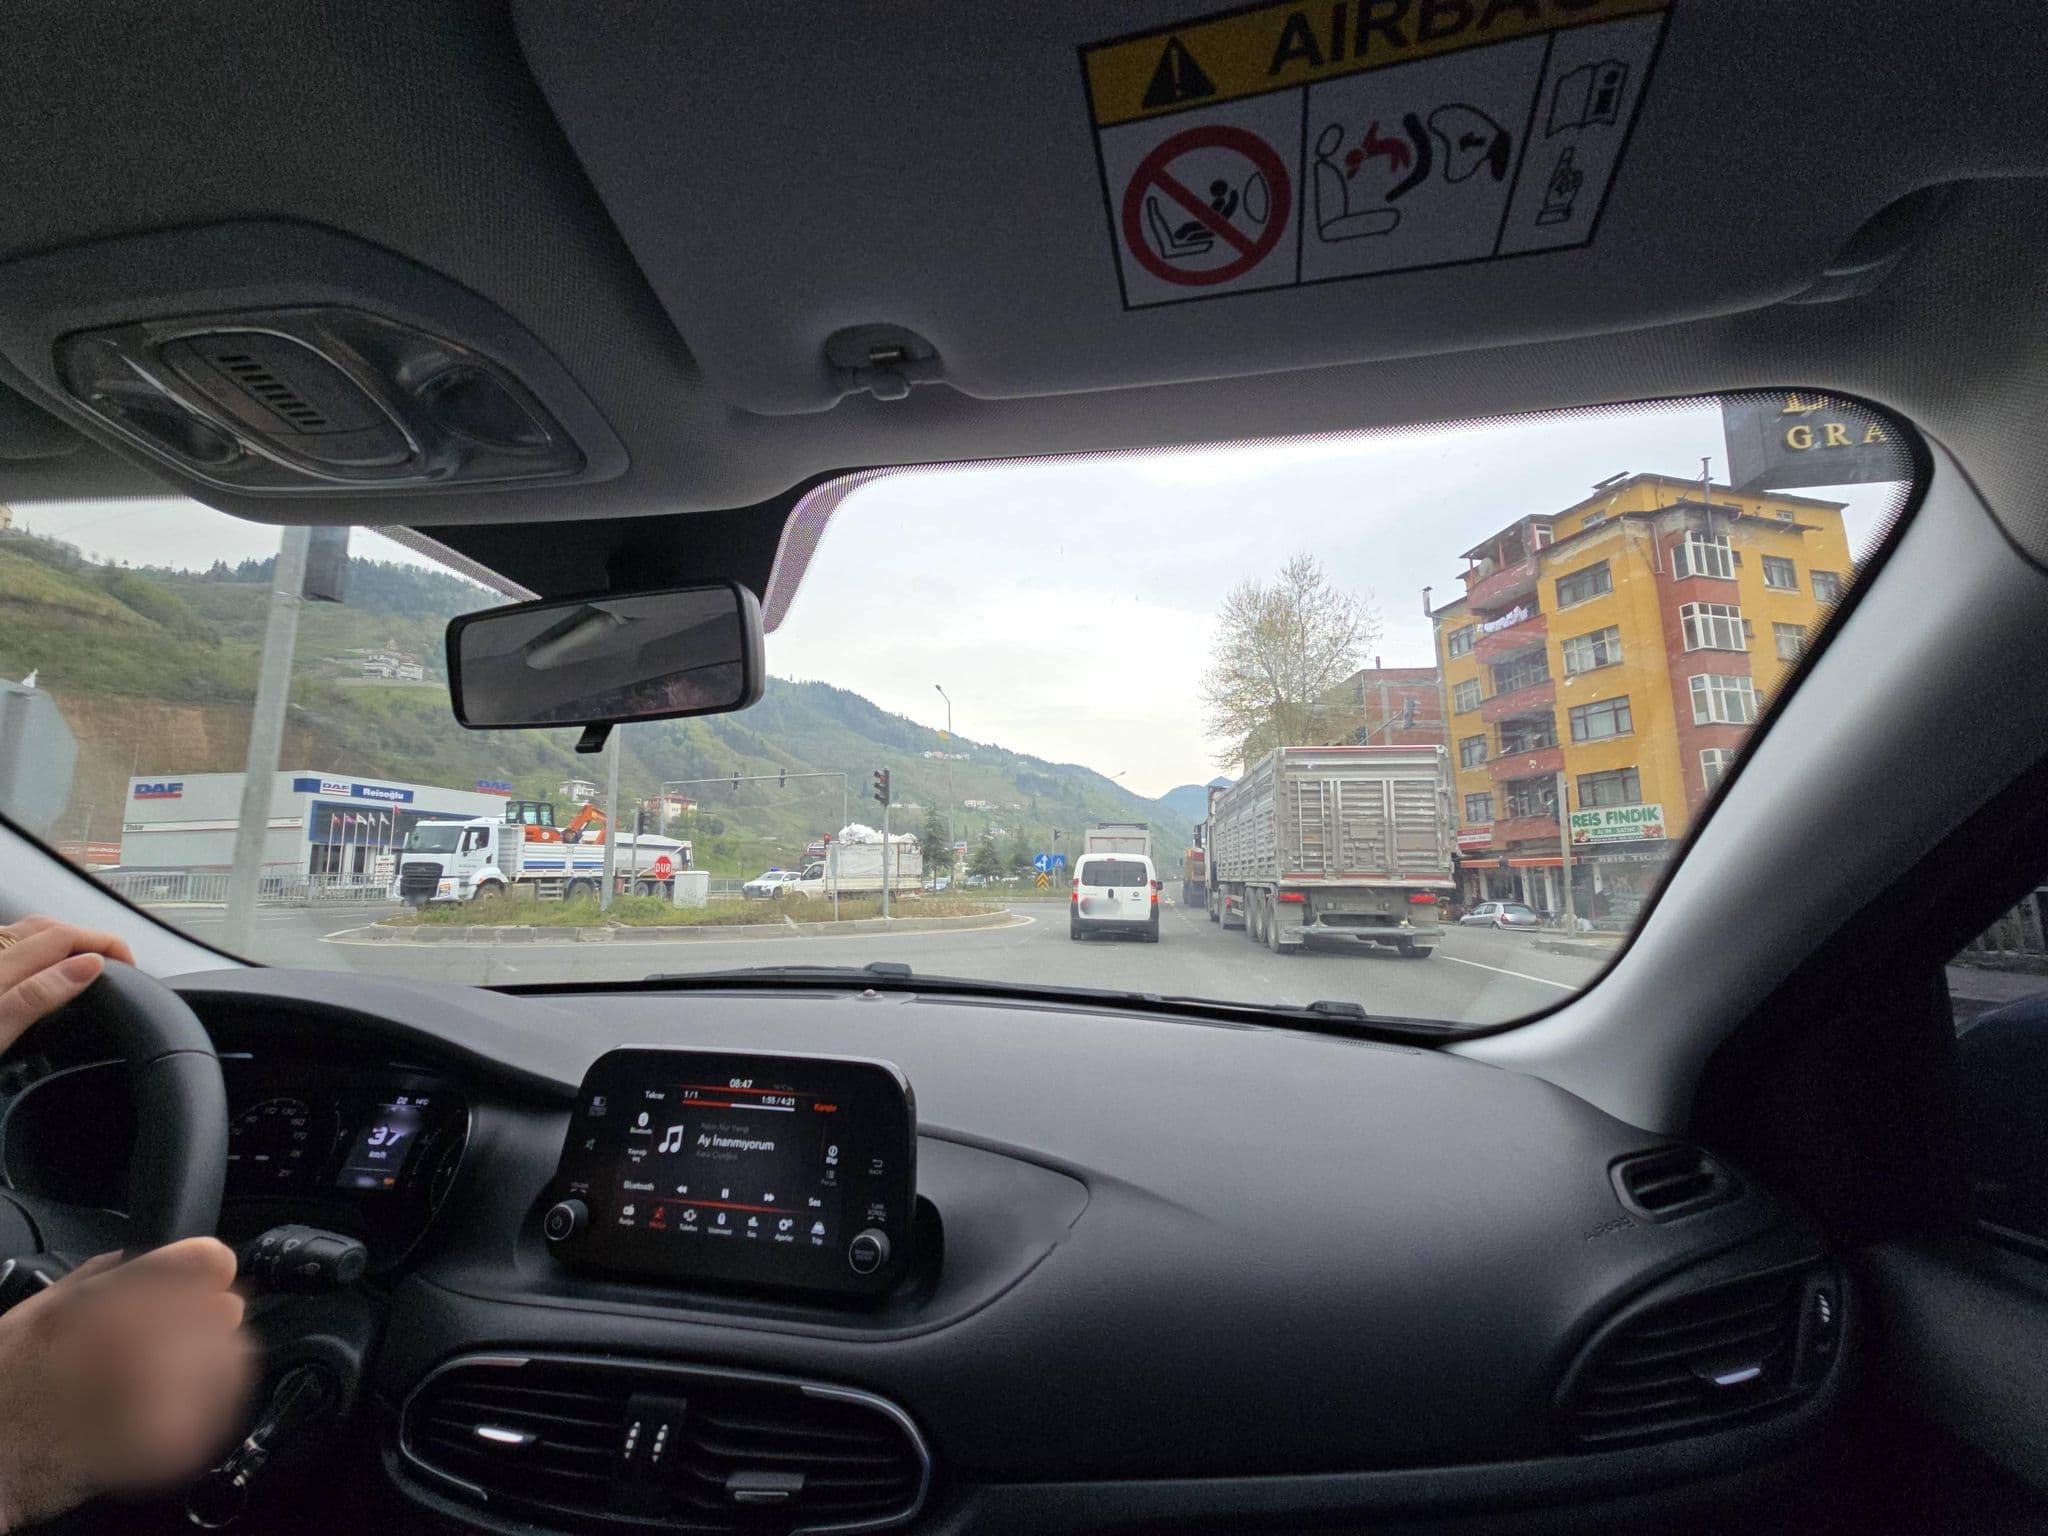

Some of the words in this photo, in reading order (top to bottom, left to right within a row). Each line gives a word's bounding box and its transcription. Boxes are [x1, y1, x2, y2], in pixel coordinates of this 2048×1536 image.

[134, 783, 184, 794] DAF
[322, 782, 350, 790] DAF
[363, 787, 404, 800] Reisoğlu
[1605, 806, 1660, 825] FINDIK
[655, 863, 671, 873] DUR
[729, 1078, 753, 1088] 08:47
[367, 1126, 404, 1146] 37
[697, 1134, 711, 1147] Ay
